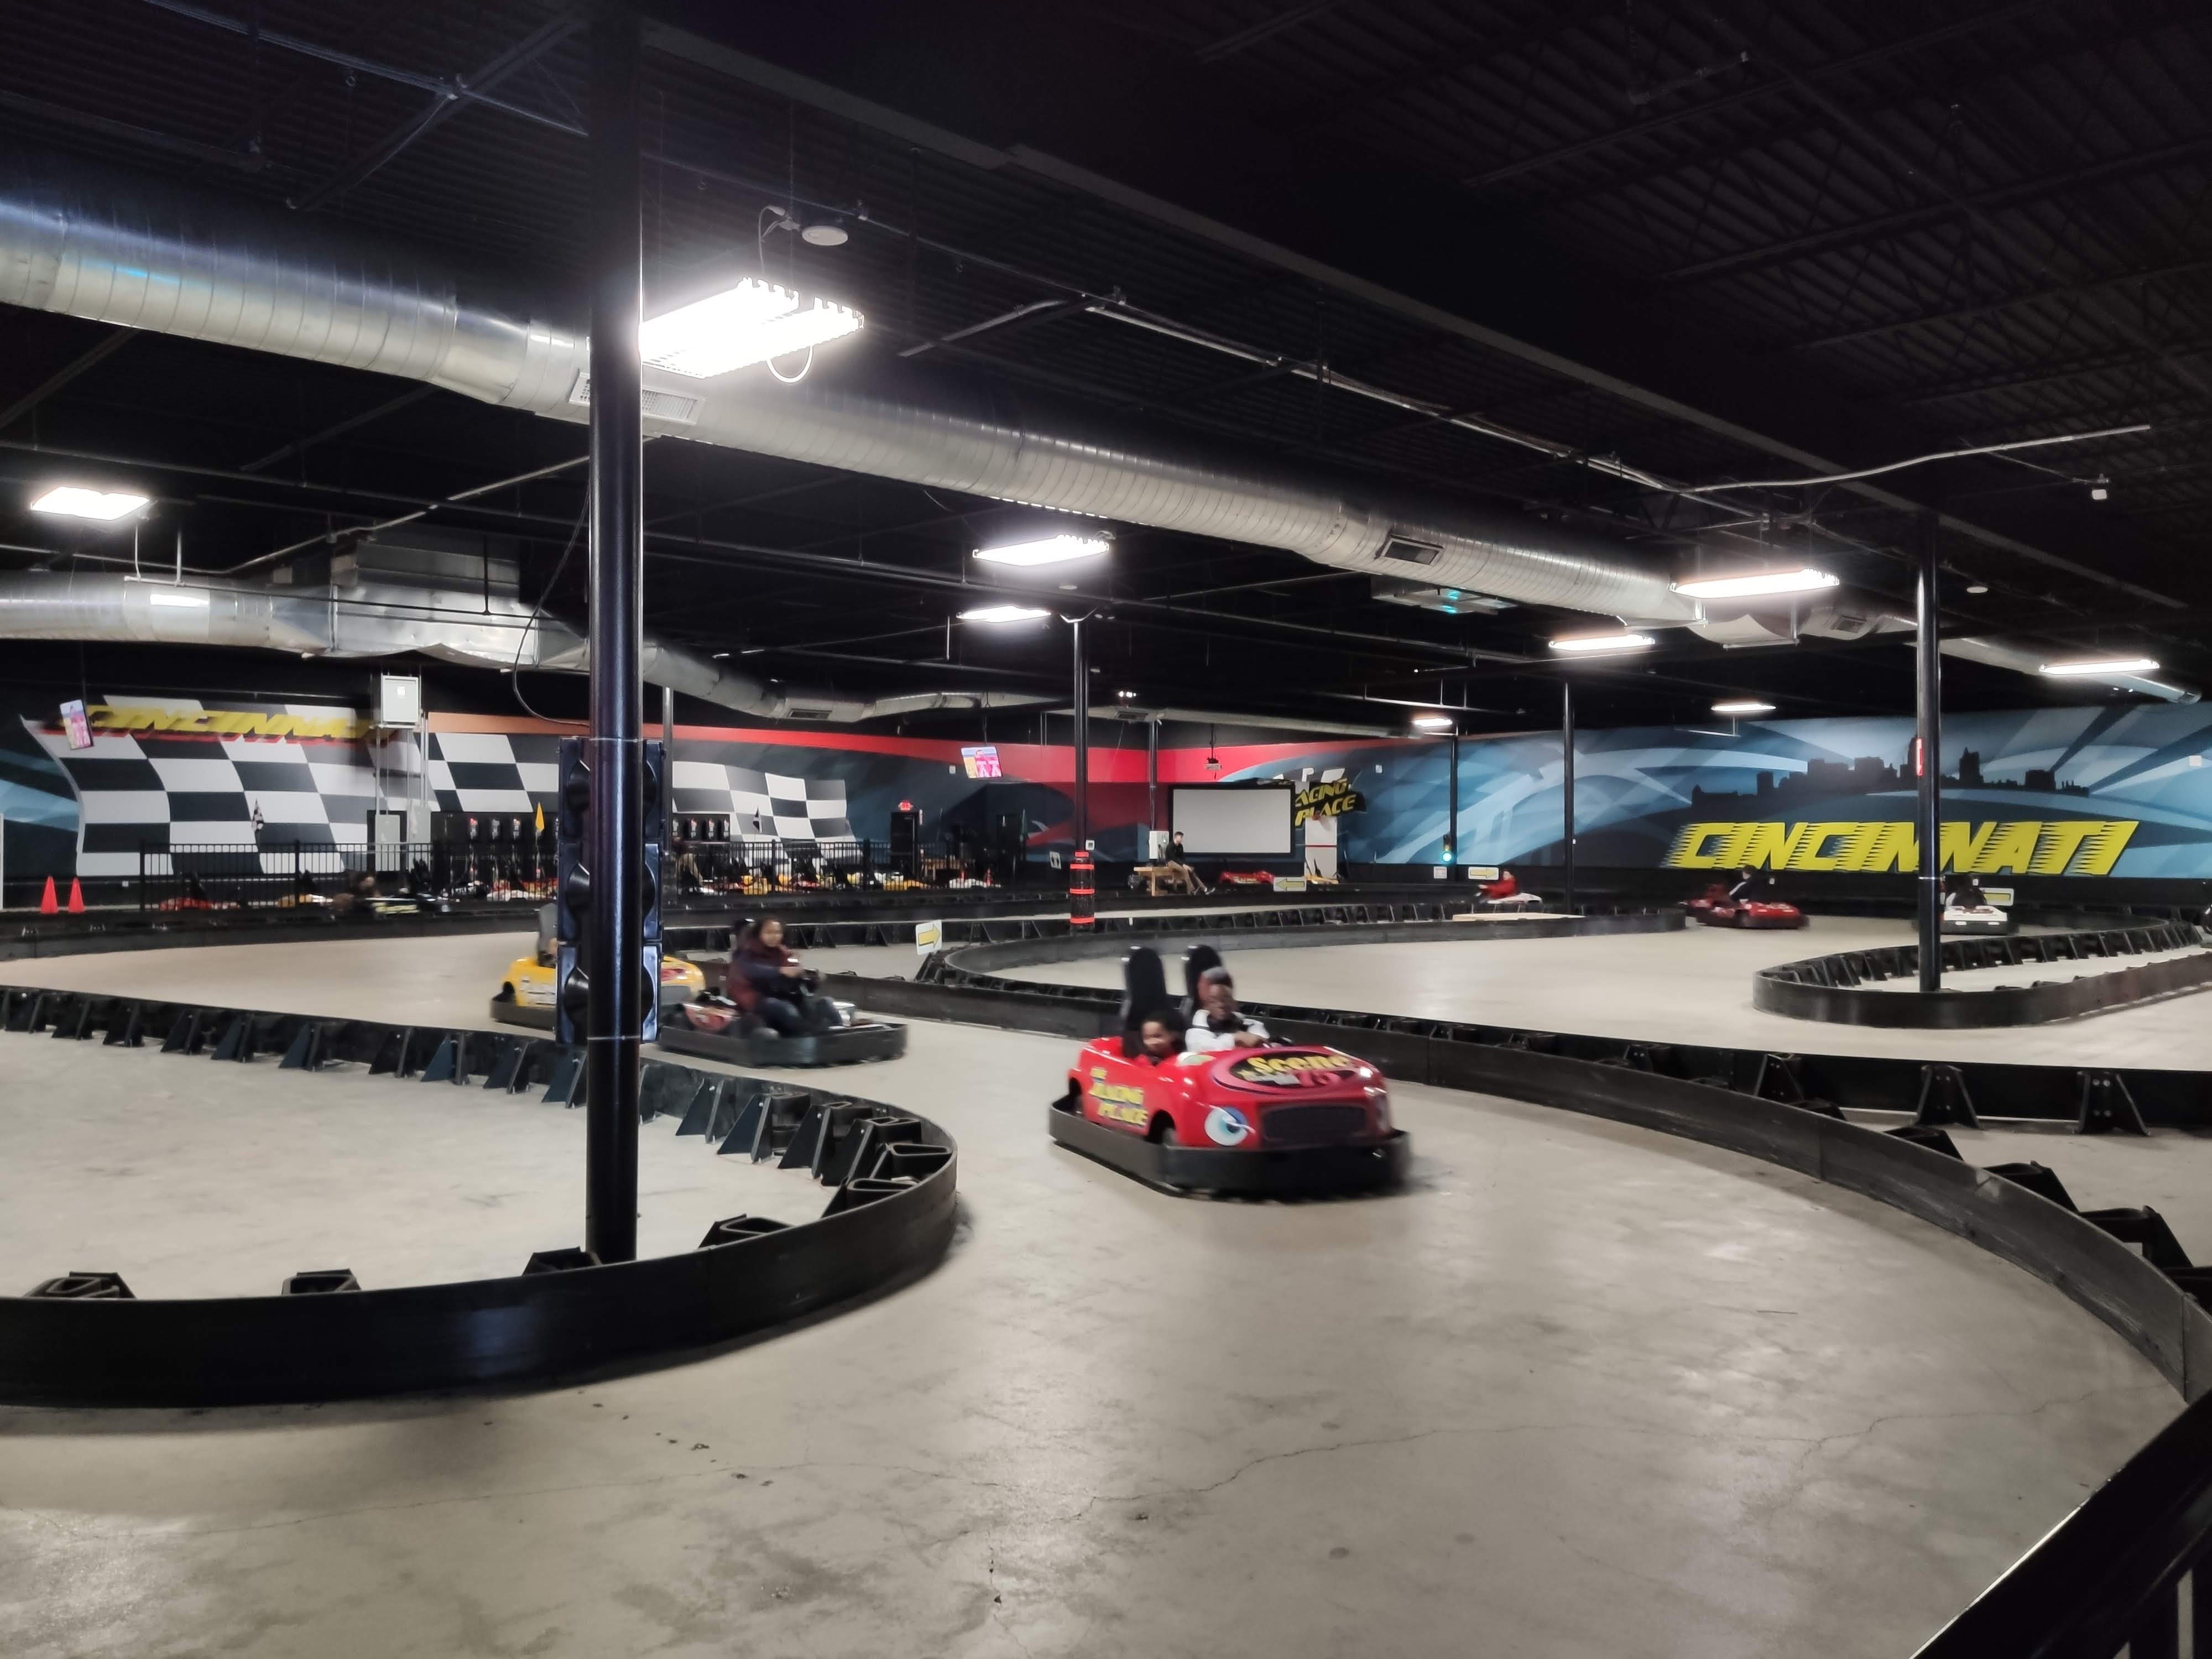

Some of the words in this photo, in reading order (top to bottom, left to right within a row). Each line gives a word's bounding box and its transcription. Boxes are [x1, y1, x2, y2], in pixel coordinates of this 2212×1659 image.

[1295, 778, 1348, 807] ACING
[1295, 794, 1357, 826] PLACE
[1658, 821, 2139, 874] CINCINNATI
